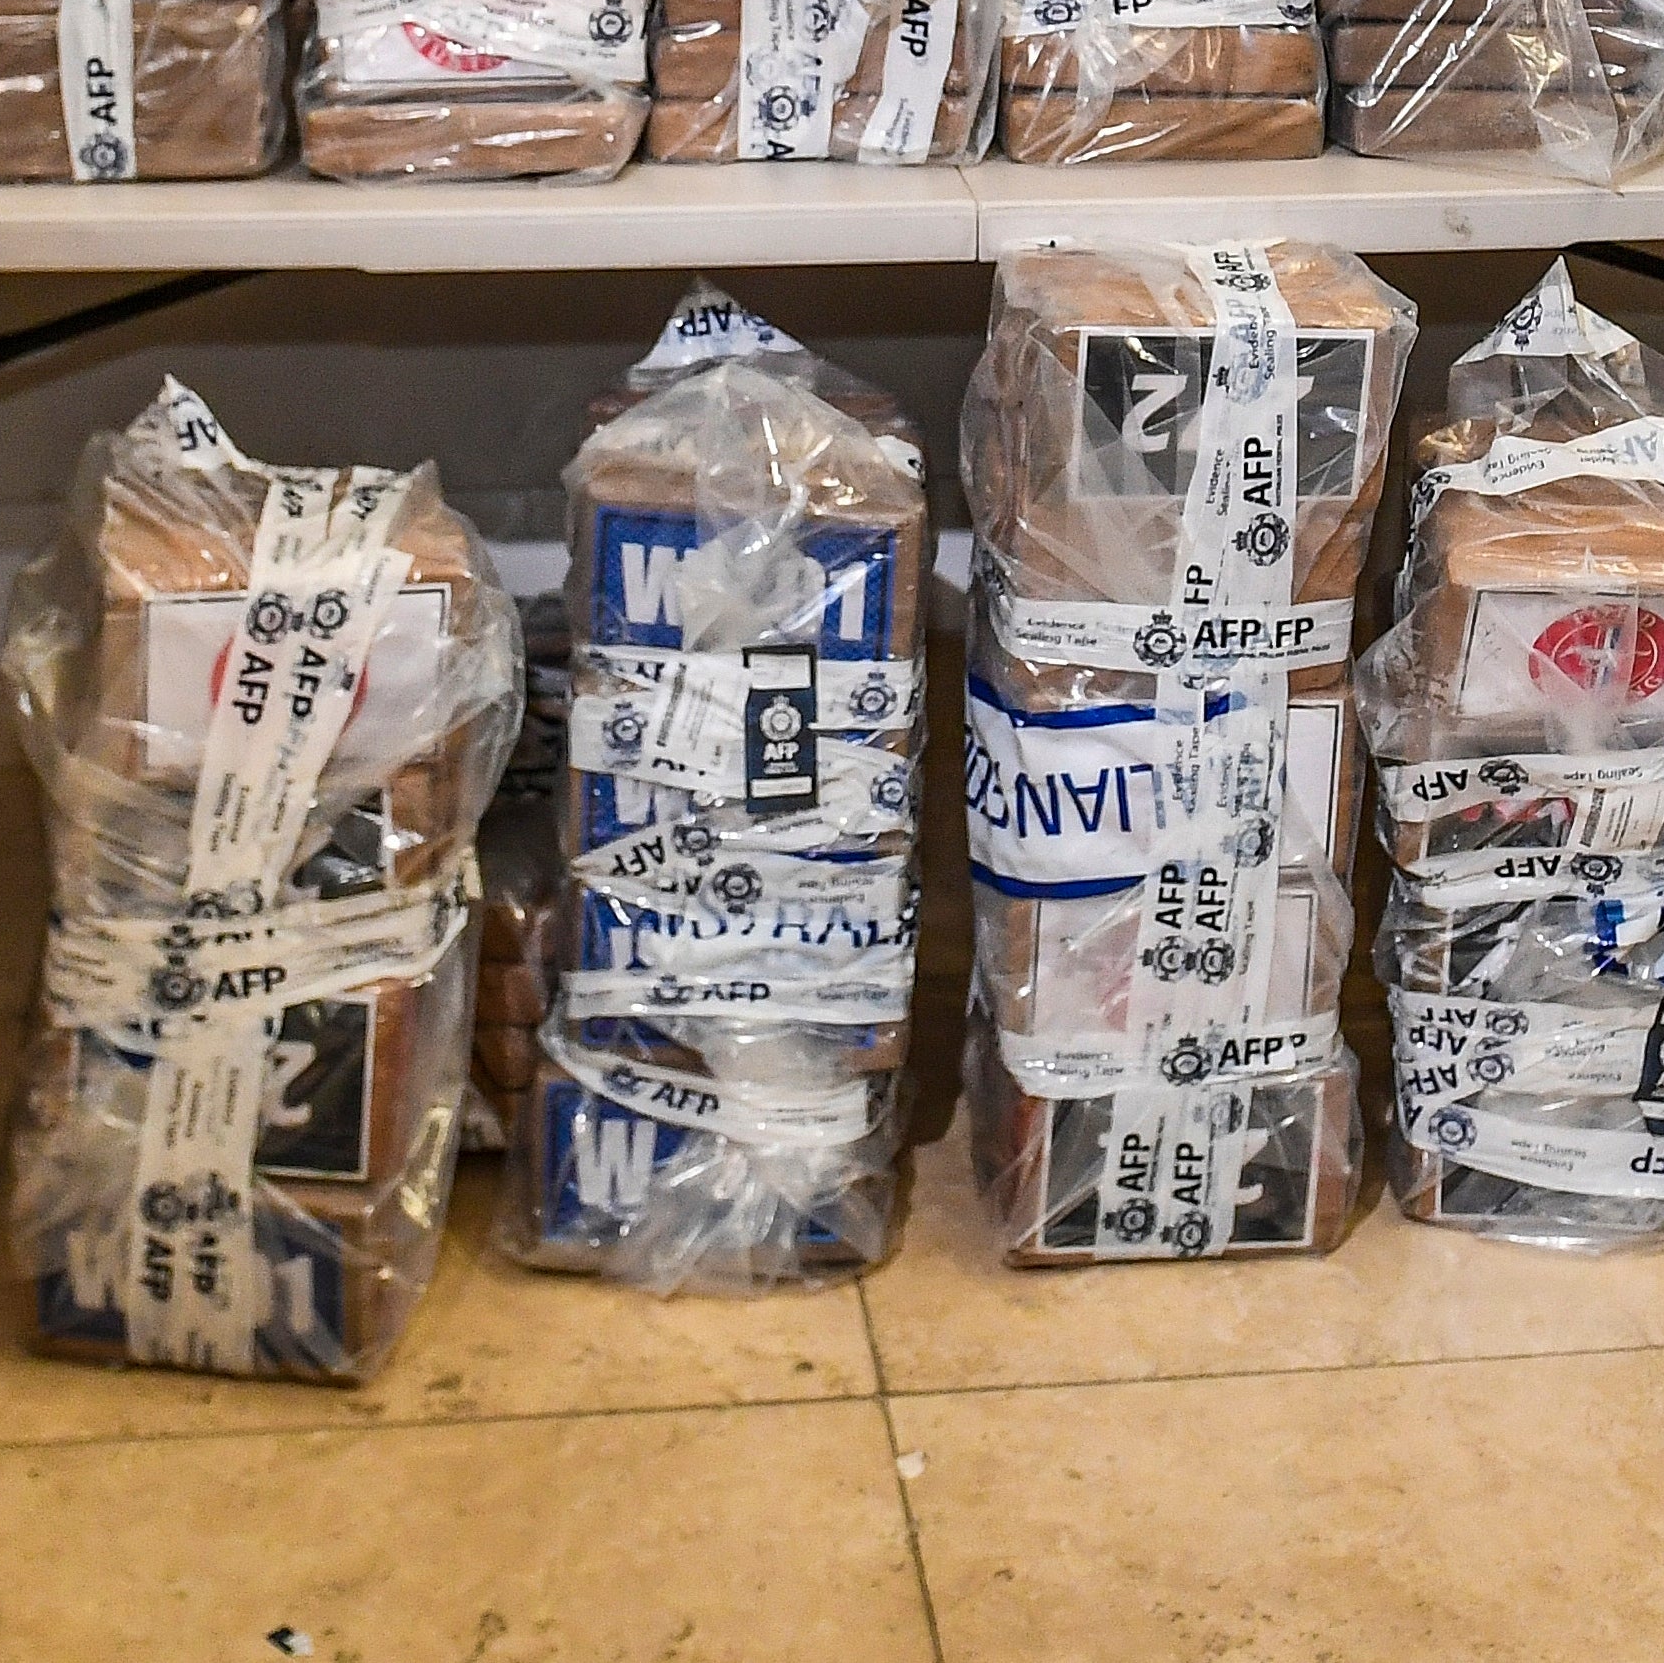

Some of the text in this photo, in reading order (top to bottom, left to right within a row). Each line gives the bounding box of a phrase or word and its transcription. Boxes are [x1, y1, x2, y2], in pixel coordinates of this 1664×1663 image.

[88, 57, 118, 127] AFP
[1243, 436, 1273, 507] AFP
[1192, 619, 1261, 650] AFP
[232, 652, 276, 726] AFP
[290, 644, 328, 719] AFP
[763, 741, 799, 762] AFP
[1411, 768, 1469, 802] AFP
[1155, 863, 1189, 930] AFP
[1494, 854, 1562, 879] AFP
[1195, 865, 1229, 933] AFP
[213, 966, 287, 1002] AFP
[1217, 1038, 1284, 1068] AFP
[653, 1083, 721, 1116] AFP
[1115, 1132, 1151, 1193] AFP
[1172, 1142, 1206, 1206] AFP
